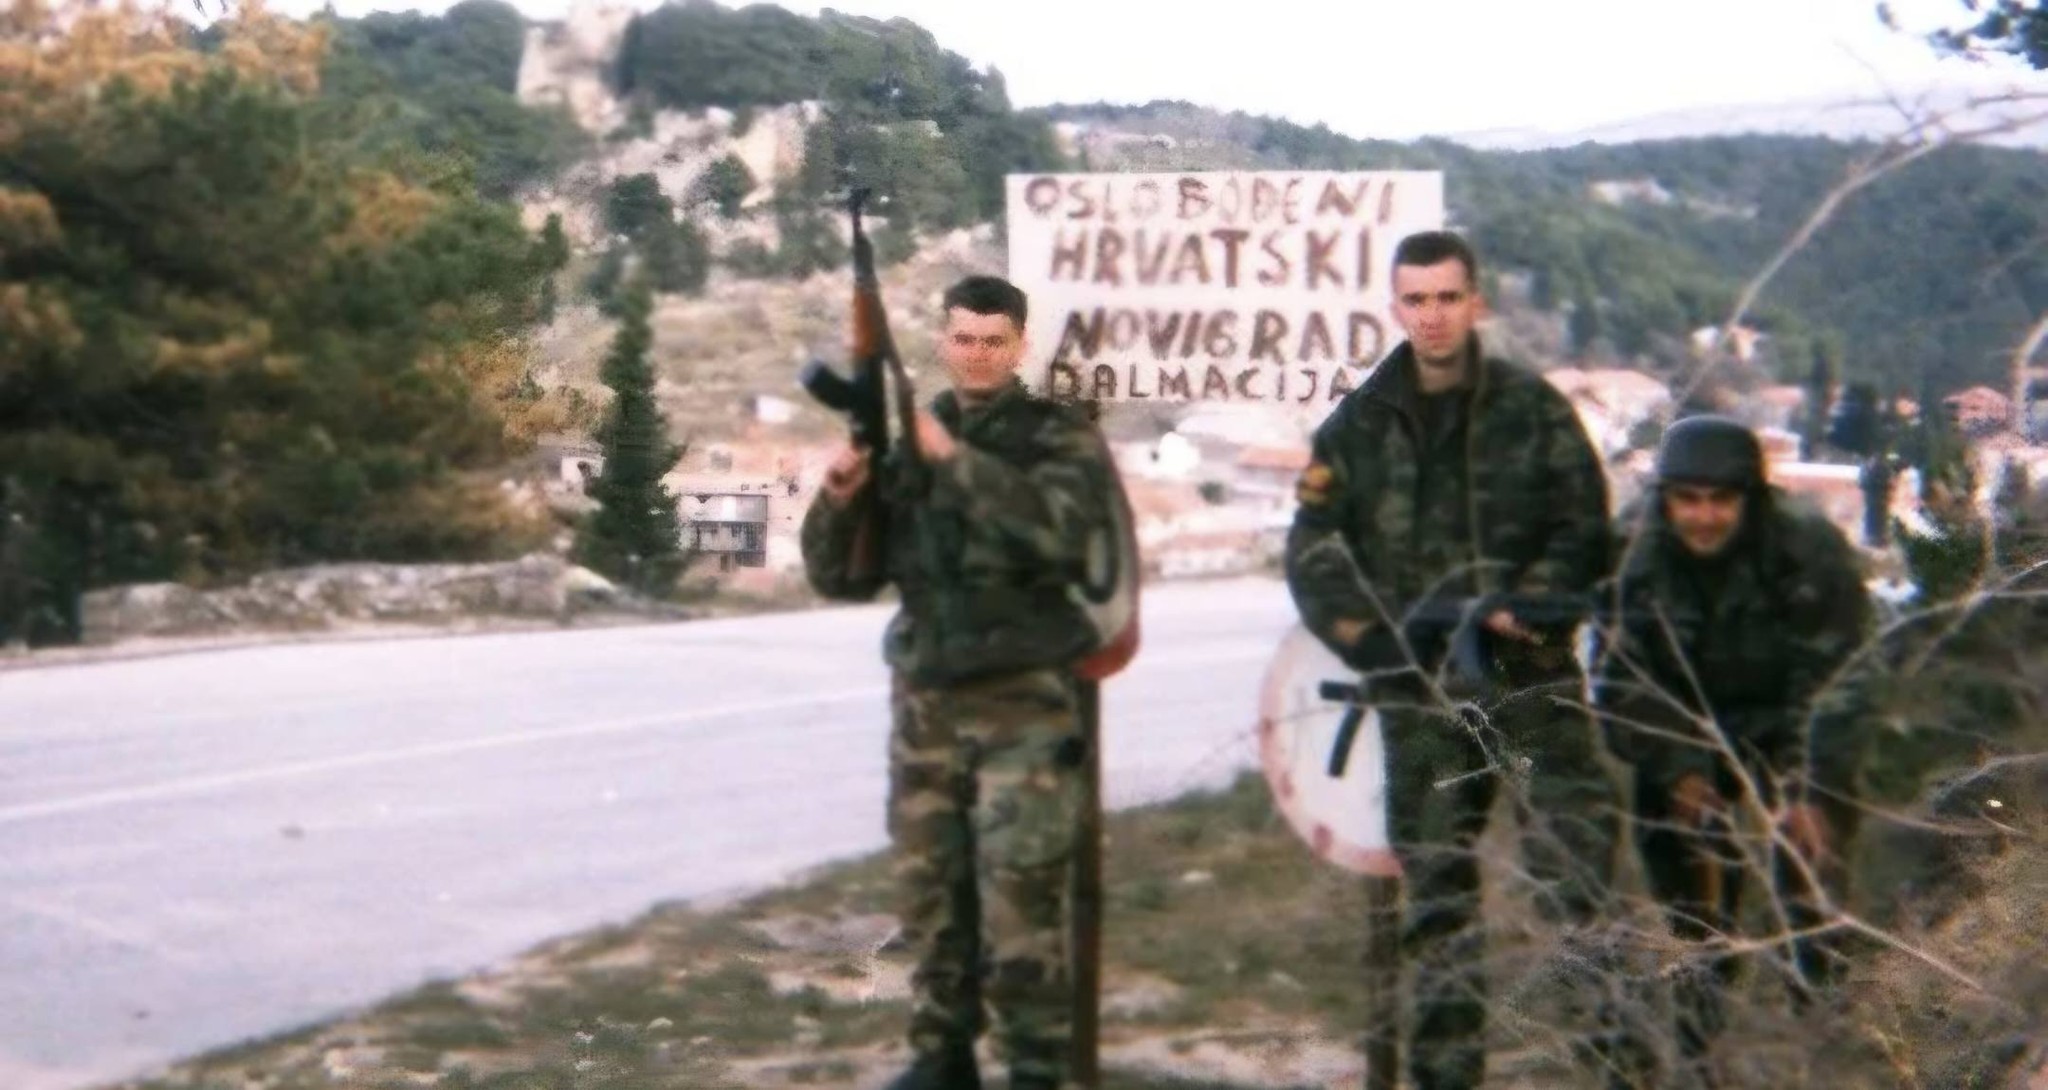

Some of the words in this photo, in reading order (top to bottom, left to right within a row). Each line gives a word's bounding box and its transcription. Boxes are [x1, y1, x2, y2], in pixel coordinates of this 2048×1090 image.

[1049, 228, 1370, 291] HRVATSKI
[1054, 307, 1384, 369] NOVIGRAD
[1047, 361, 1356, 402] DALMACIJA
